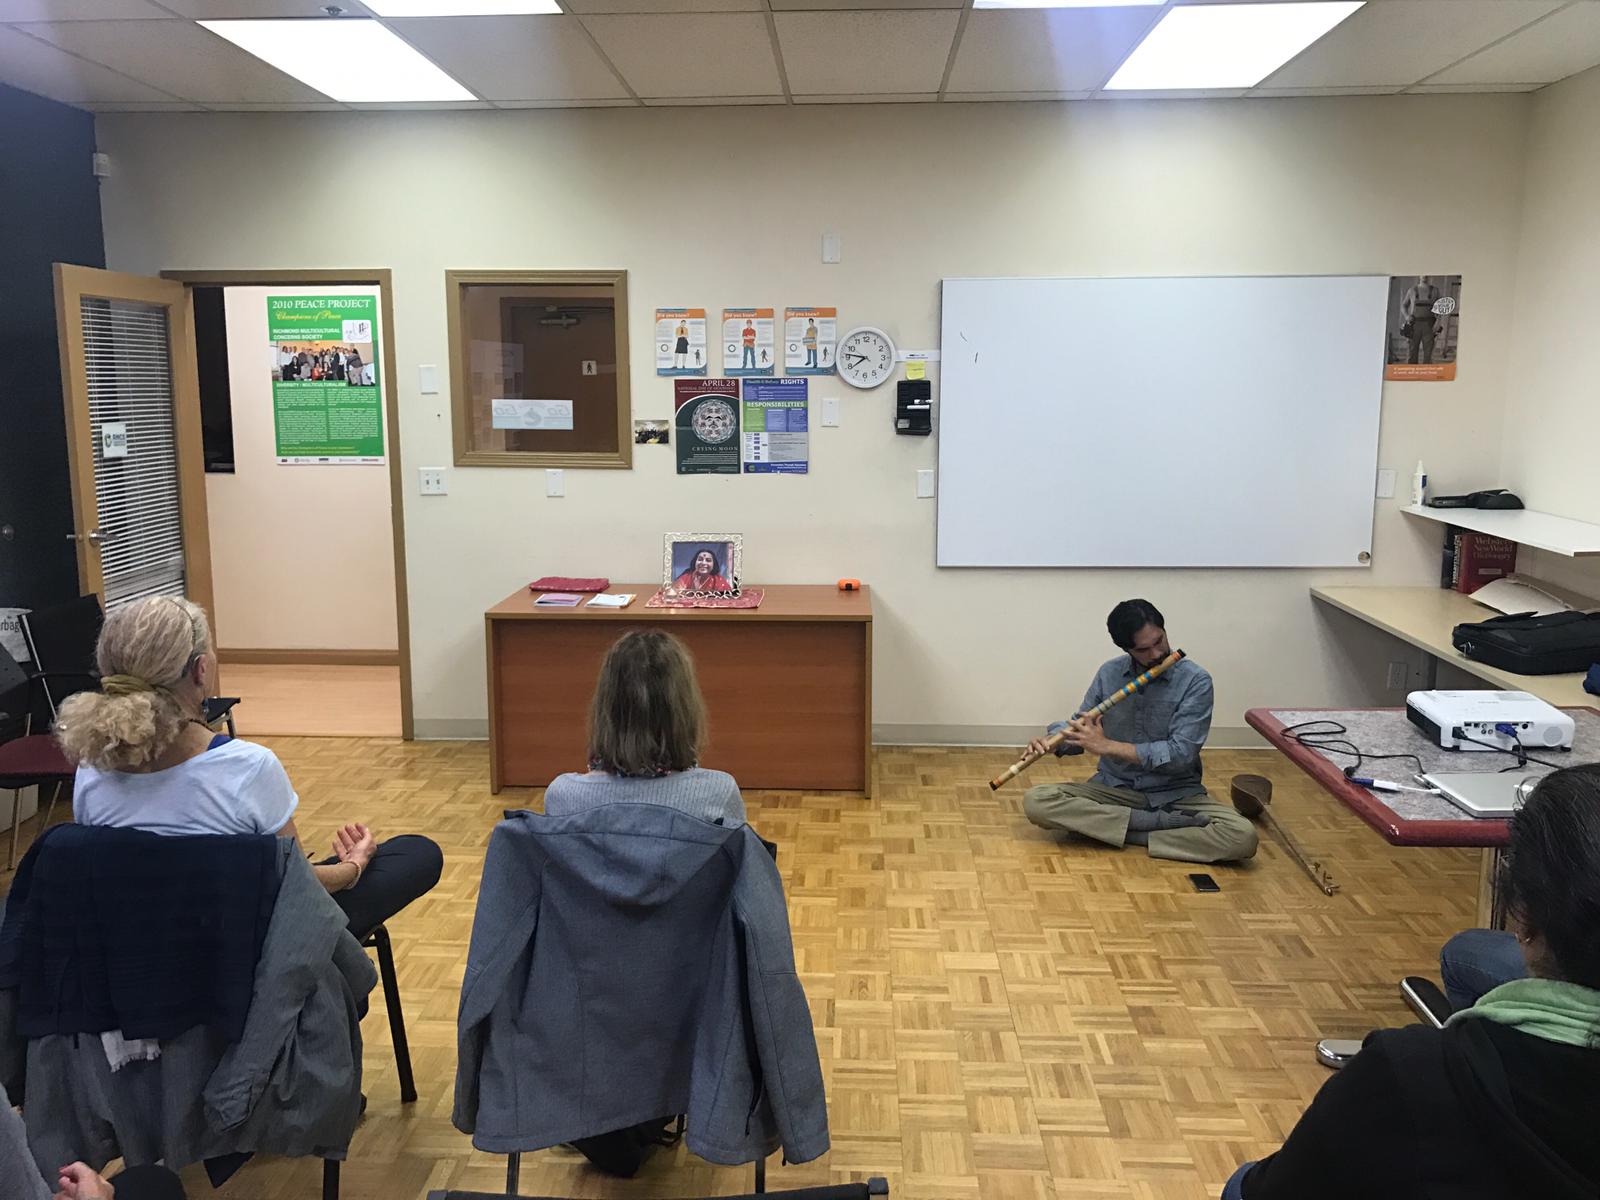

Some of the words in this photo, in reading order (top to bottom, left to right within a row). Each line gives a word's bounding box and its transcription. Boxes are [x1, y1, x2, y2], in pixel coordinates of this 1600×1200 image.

[272, 301, 293, 309] 2010
[295, 300, 325, 308] PEACE
[327, 299, 370, 308] PROJECT
[275, 311, 312, 321] Champions
[312, 313, 320, 321] of
[321, 310, 341, 319] Peace
[701, 379, 725, 387] APRIL
[726, 379, 736, 387] 28
